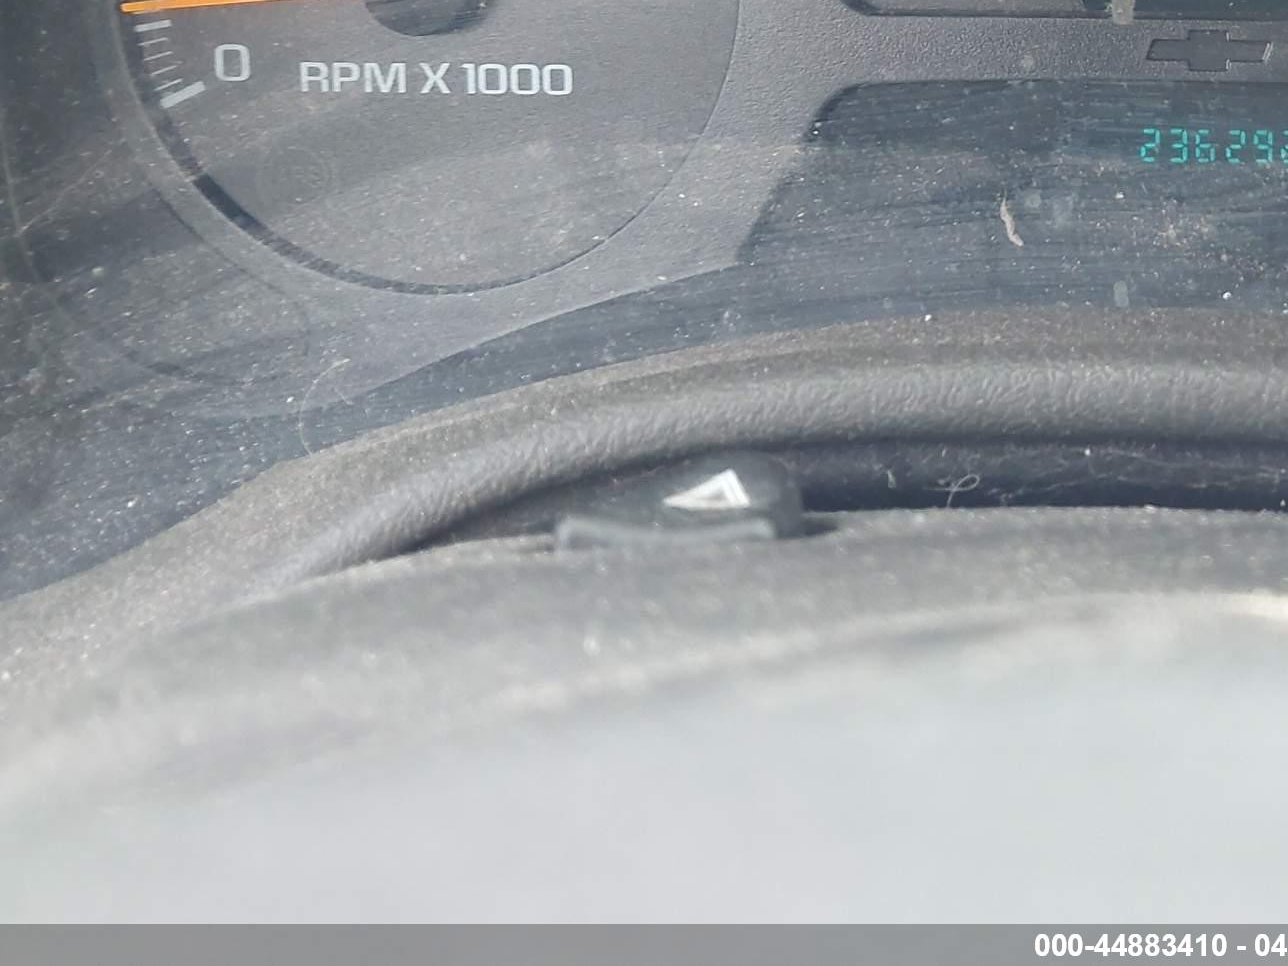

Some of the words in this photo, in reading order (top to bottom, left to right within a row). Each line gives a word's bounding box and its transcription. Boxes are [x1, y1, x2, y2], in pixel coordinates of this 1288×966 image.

[214, 44, 251, 82] 0
[301, 62, 406, 92] RPM
[419, 63, 451, 93] X
[462, 63, 574, 95] 1000
